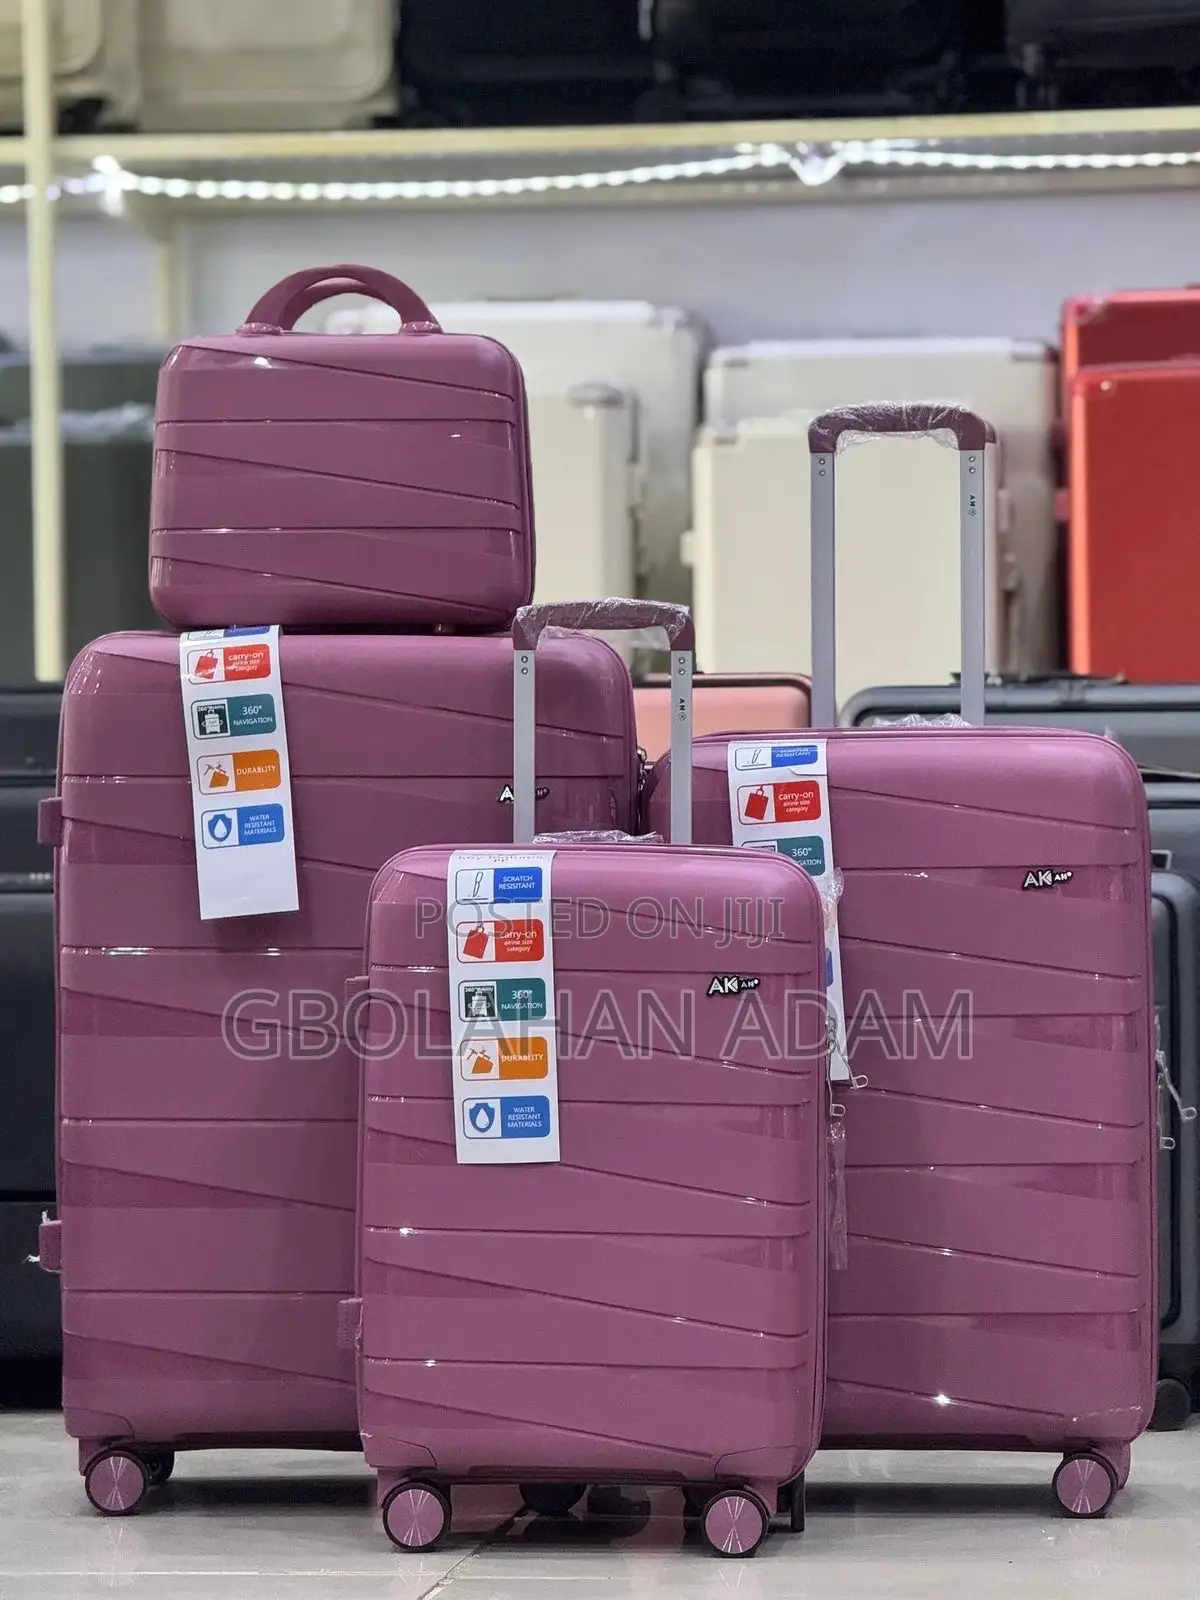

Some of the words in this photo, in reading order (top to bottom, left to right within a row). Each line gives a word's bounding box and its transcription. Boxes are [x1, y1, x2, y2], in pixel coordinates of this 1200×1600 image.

[228, 651, 264, 661] carry-on
[233, 717, 273, 726] NAVIGATION
[778, 791, 814, 802] carry-on
[785, 806, 809, 814] category
[249, 814, 270, 822] WATER
[244, 820, 275, 829] RESISTANT
[244, 827, 277, 836] MATERIALS
[503, 875, 533, 883] SCRATCH
[500, 930, 537, 940] carry-on
[506, 945, 531, 953] category
[501, 1002, 543, 1010] NAVIGATION
[507, 1113, 541, 1121] RESISTANT
[507, 1120, 542, 1128] MATERIALS
